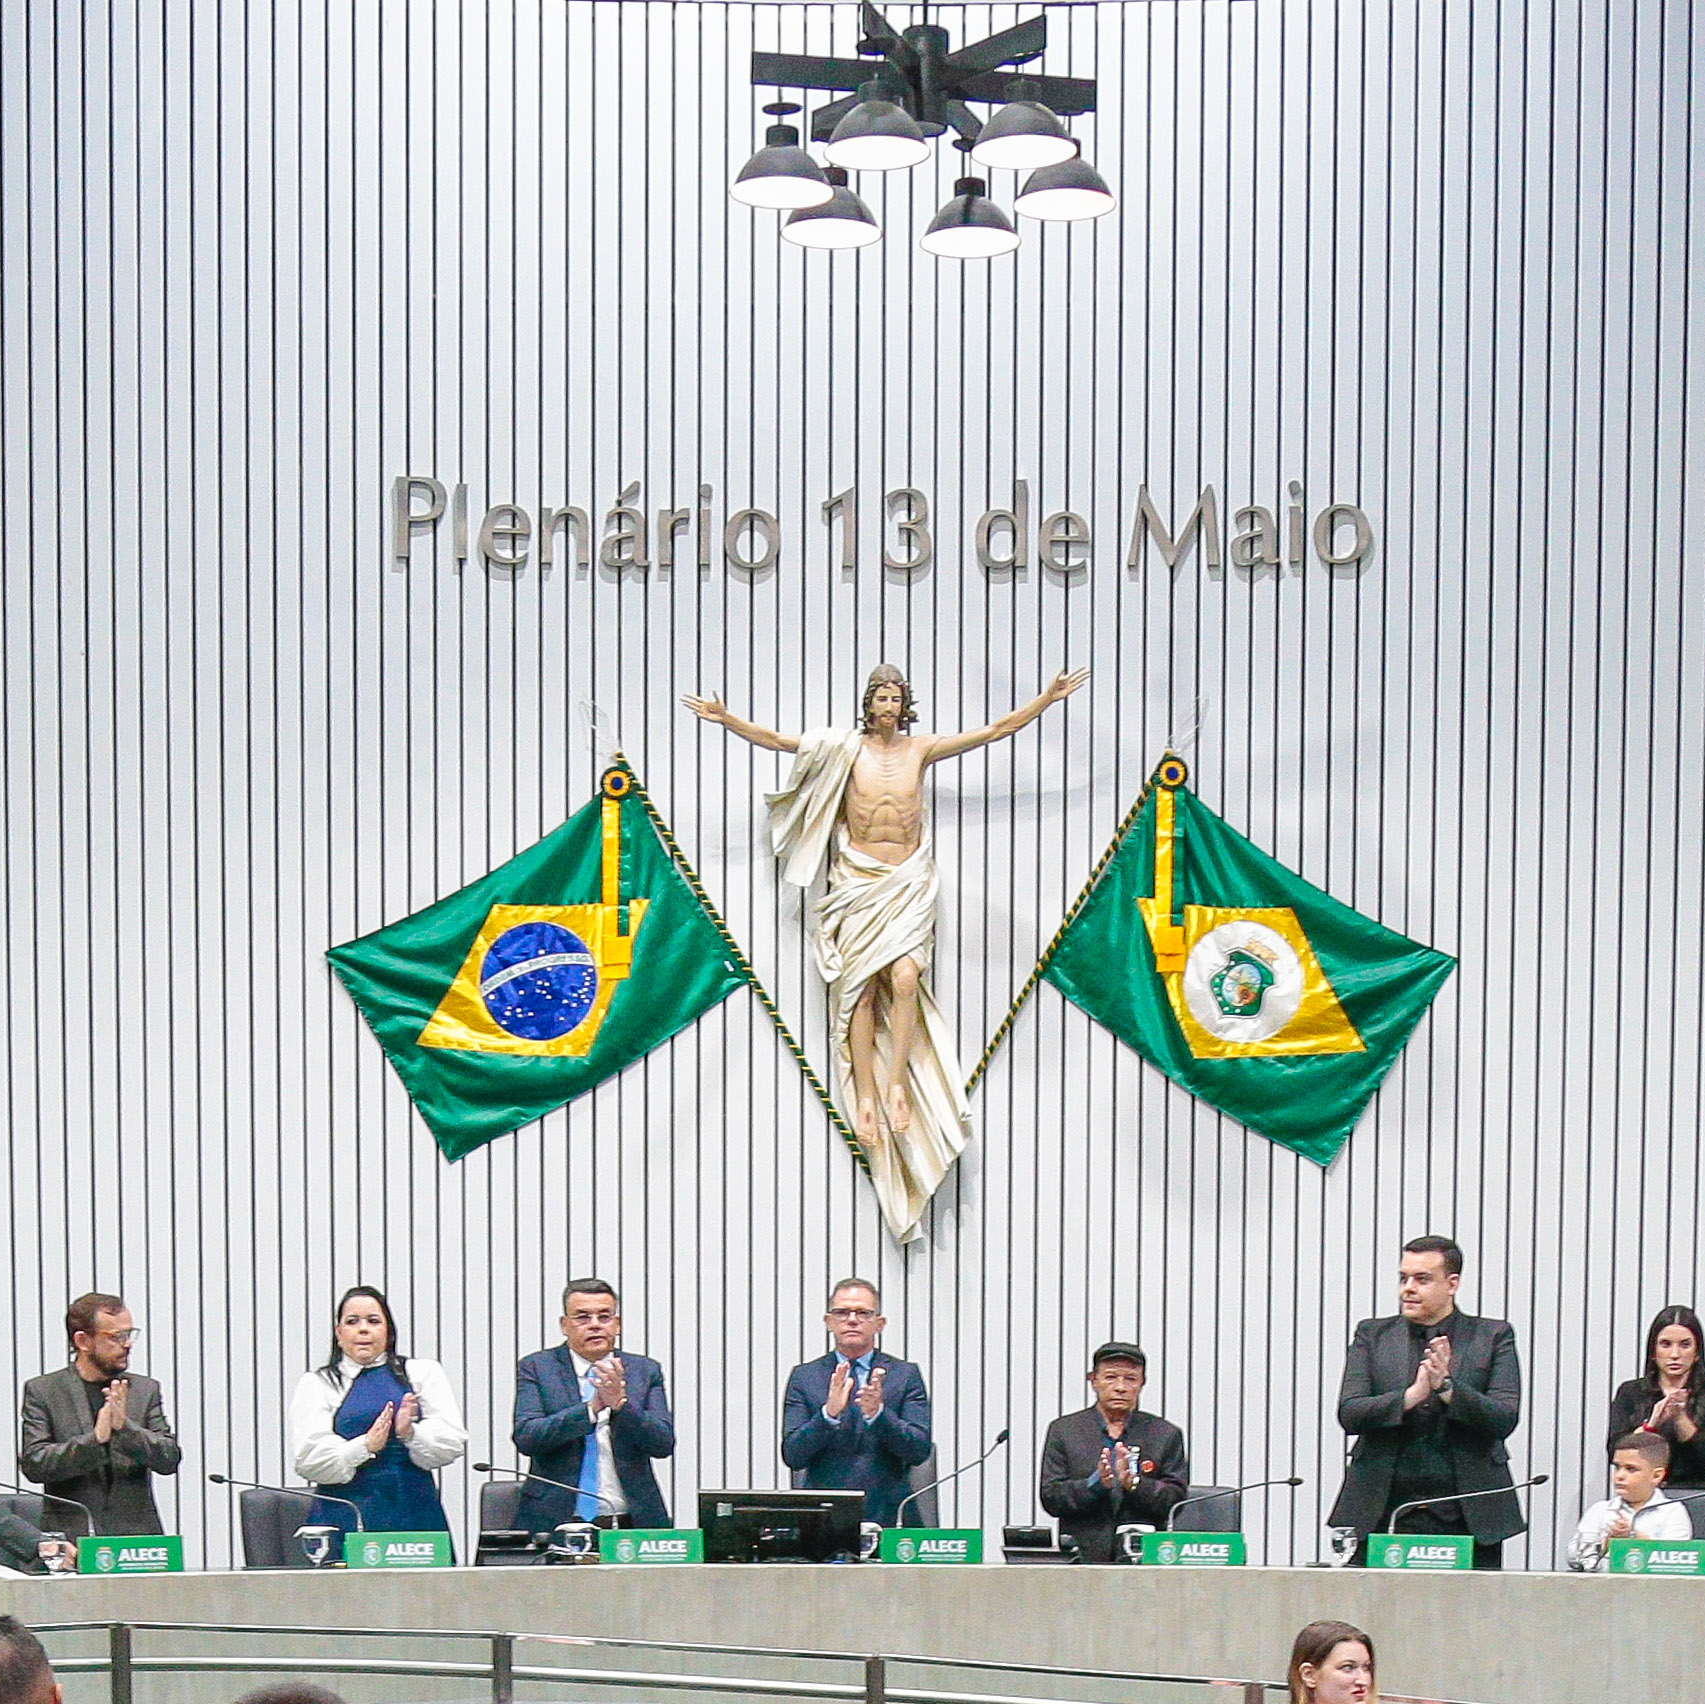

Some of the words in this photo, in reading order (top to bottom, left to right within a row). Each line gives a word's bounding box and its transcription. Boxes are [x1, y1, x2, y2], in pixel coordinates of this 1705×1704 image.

[394, 475, 782, 570] Plenário
[822, 487, 932, 569] 13
[977, 479, 1090, 571] de
[1128, 480, 1373, 569] Maio
[385, 1543, 434, 1556] ALECE
[638, 1540, 688, 1553] ALECE
[918, 1540, 967, 1553] ALECE
[1179, 1543, 1229, 1557] ALECE
[1406, 1546, 1457, 1560] ALECE
[117, 1547, 169, 1561] ALECE
[1647, 1550, 1699, 1564] ALECE
